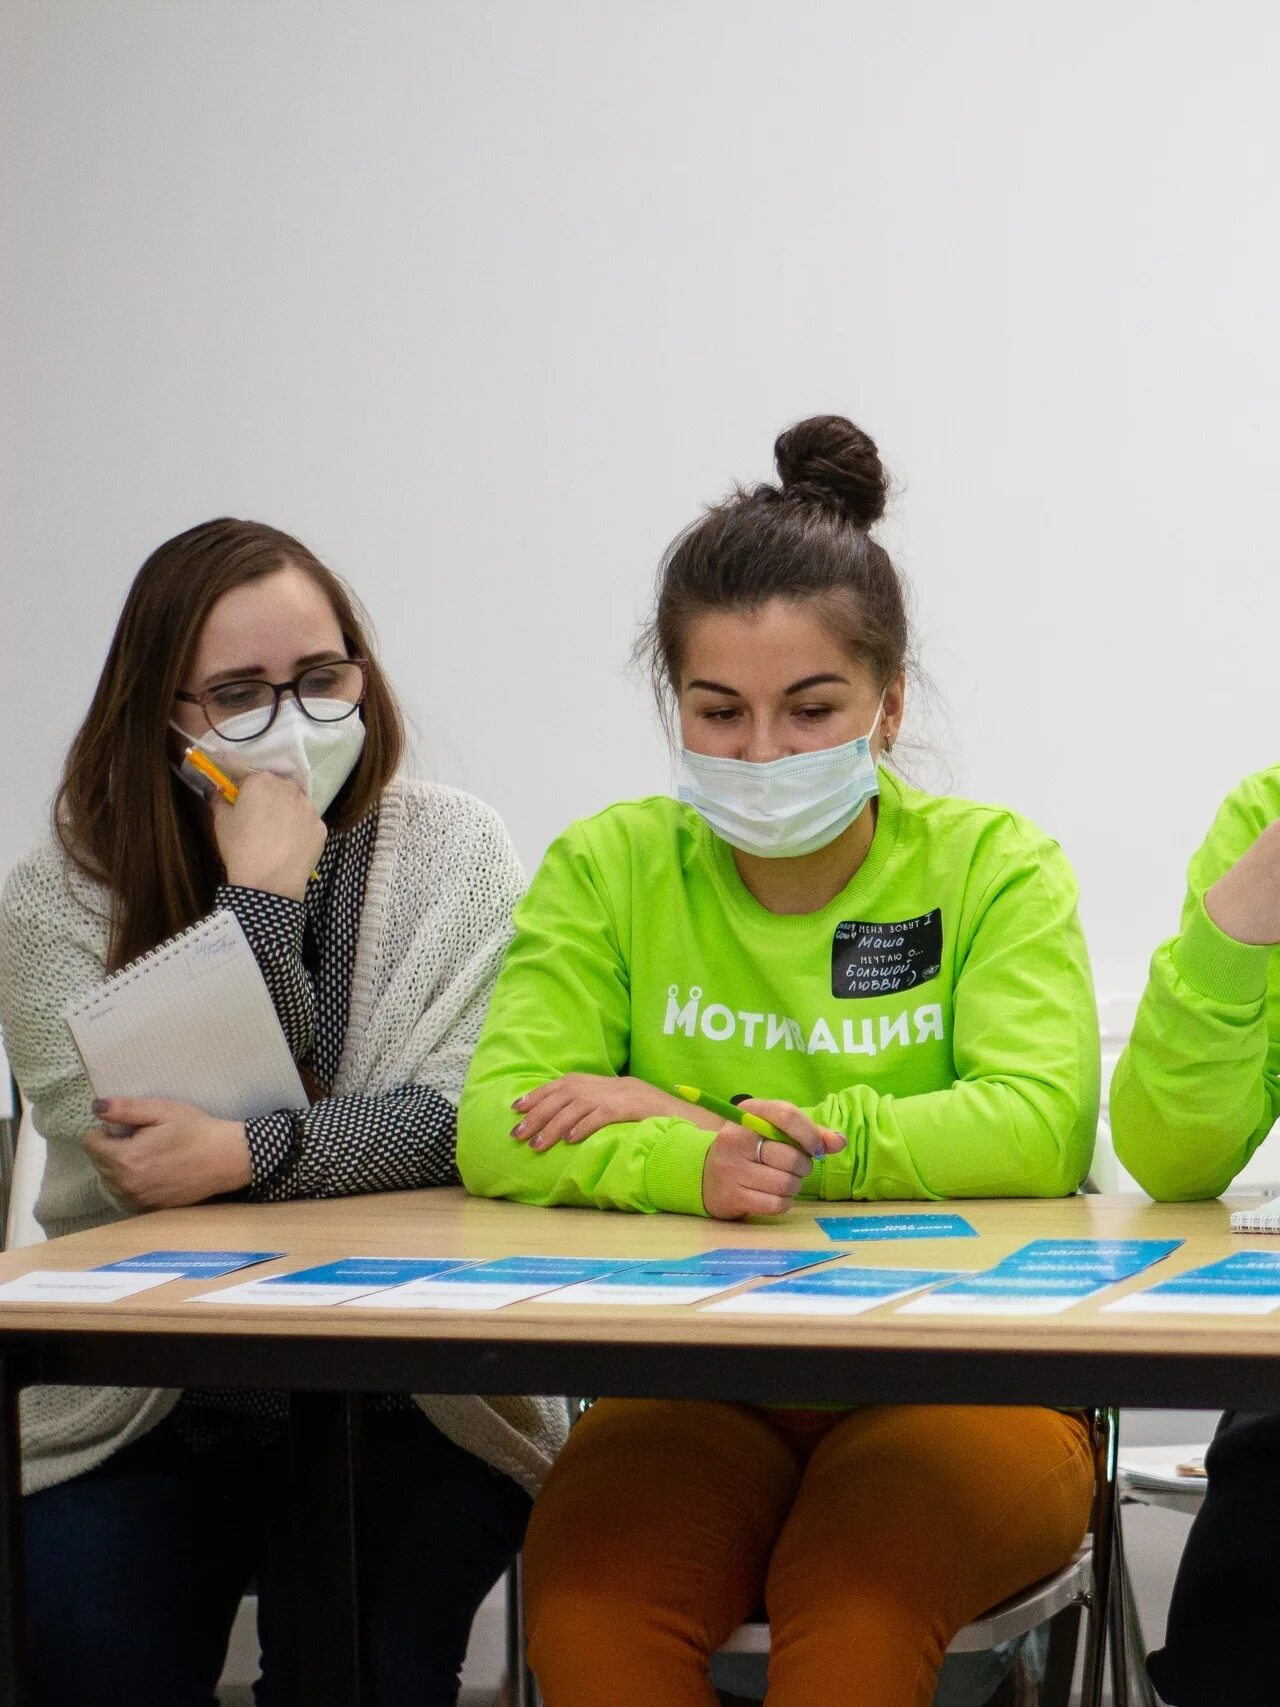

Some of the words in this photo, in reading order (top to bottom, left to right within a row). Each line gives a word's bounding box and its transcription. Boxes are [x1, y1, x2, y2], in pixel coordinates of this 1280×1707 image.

[858, 925, 884, 934] МЕНЯ
[890, 920, 920, 933] ЗОВУТ
[858, 936, 905, 949] Маша
[860, 954, 903, 964] МЕЧТАЮ
